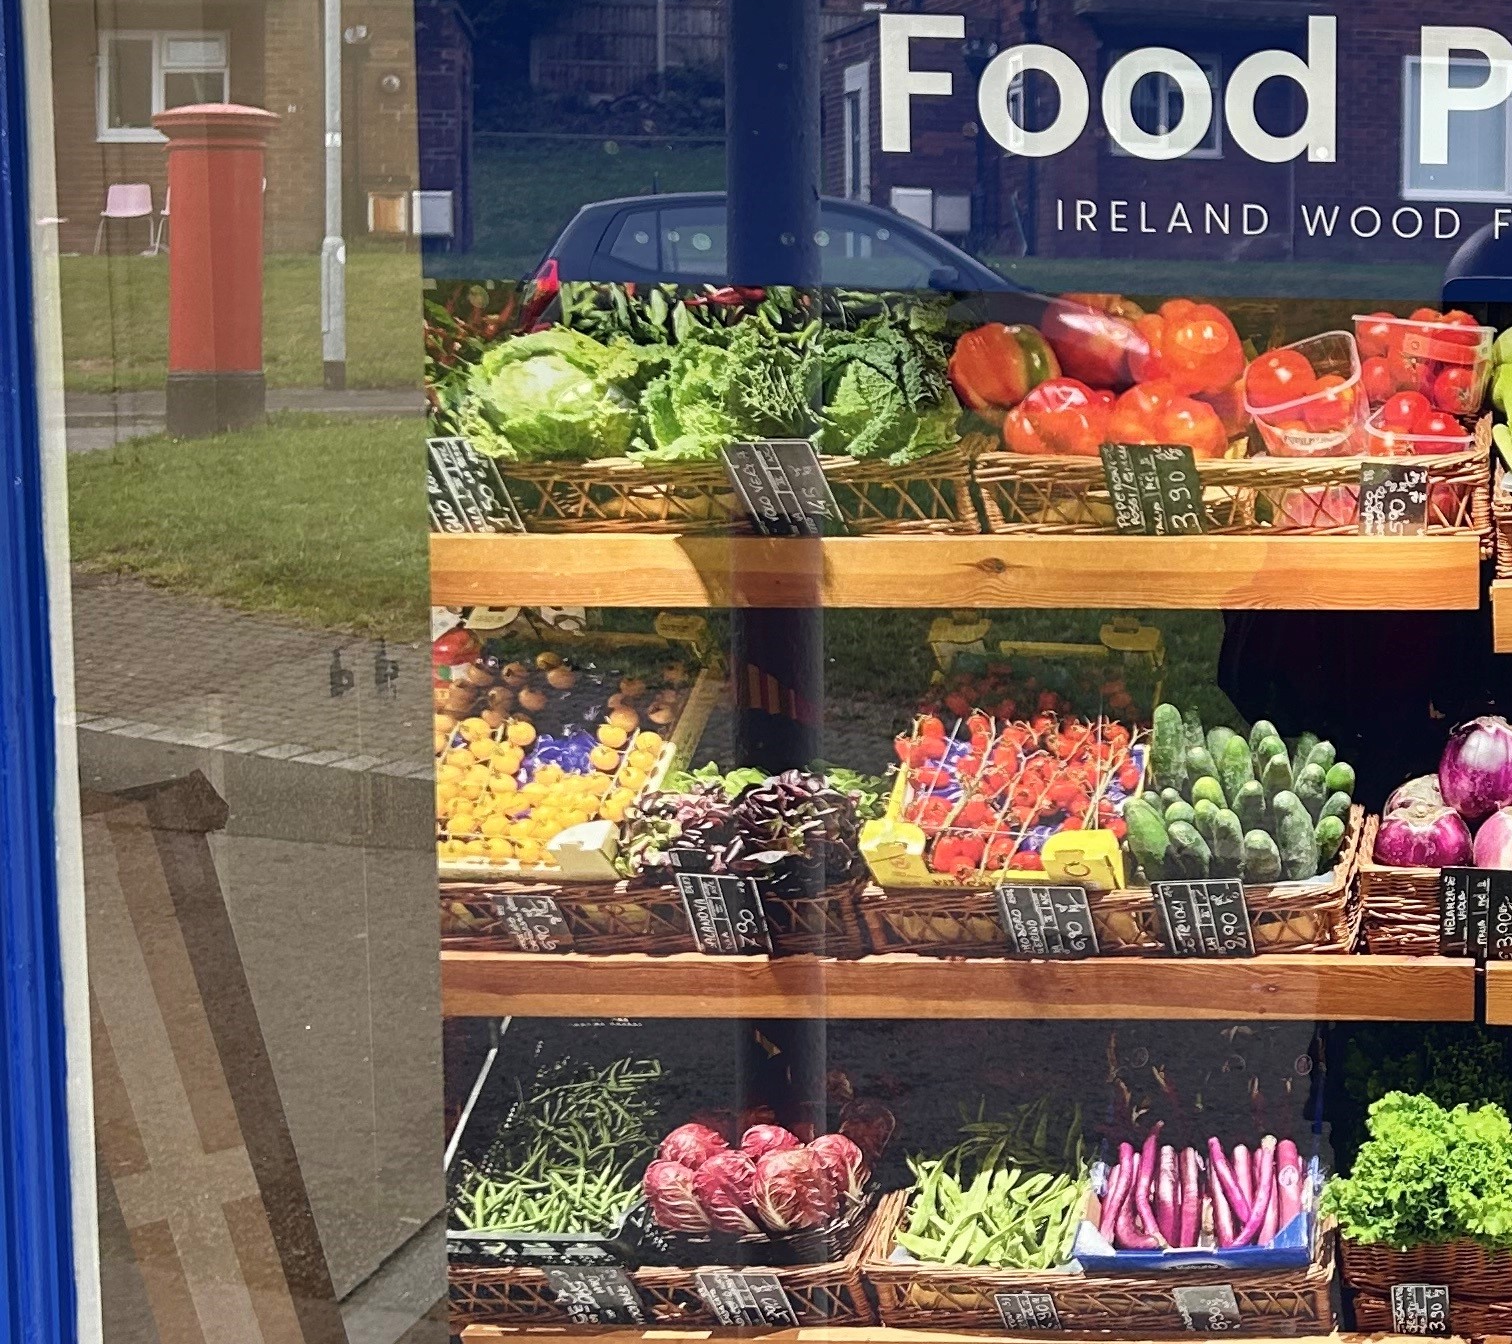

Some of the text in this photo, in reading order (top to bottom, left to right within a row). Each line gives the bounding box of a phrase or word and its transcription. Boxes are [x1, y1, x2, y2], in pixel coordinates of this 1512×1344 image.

[879, 12, 1338, 163] Food
[1056, 199, 1269, 236] IRELAND
[1300, 204, 1461, 240] WOOD
